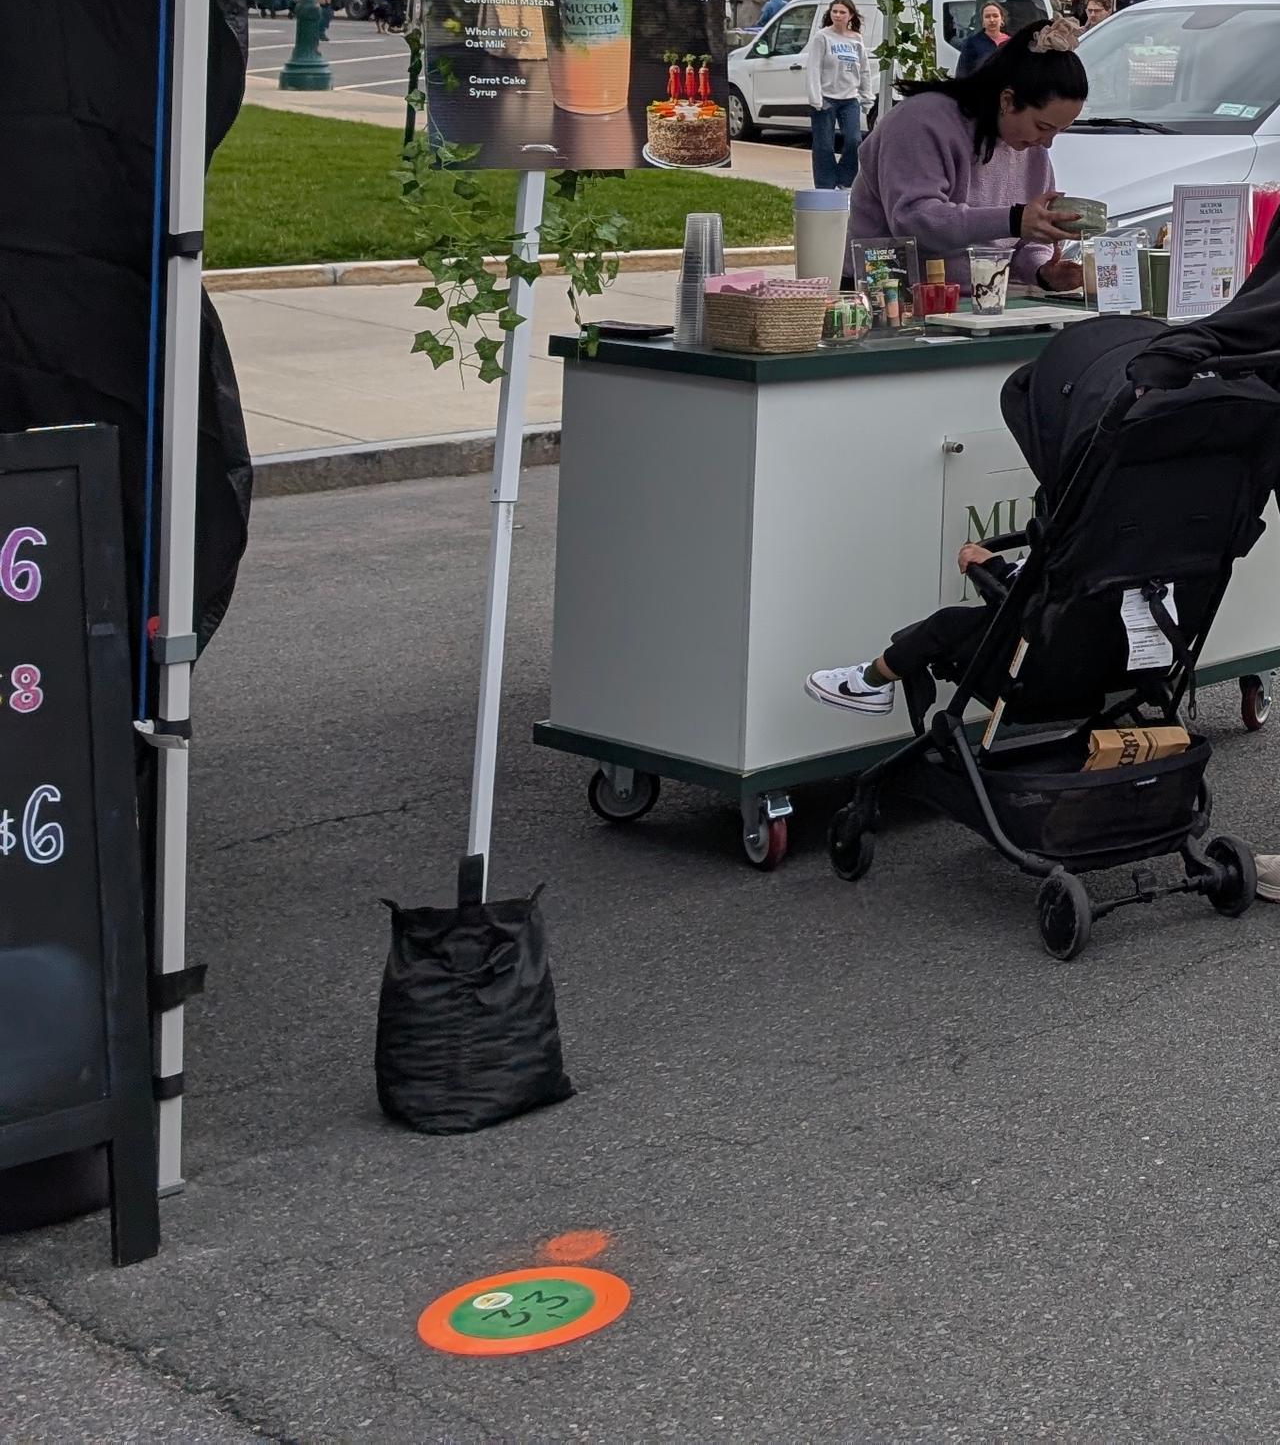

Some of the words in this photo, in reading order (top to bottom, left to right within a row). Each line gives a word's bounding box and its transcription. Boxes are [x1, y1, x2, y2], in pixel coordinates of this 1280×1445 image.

[464, 26, 497, 37] Whole
[498, 27, 519, 38] Milk
[520, 28, 533, 38] Or
[464, 39, 484, 49] Oat
[485, 39, 506, 49] Milk
[468, 75, 501, 85] Carrot
[501, 75, 527, 85] Cake
[468, 87, 498, 99] Syrup
